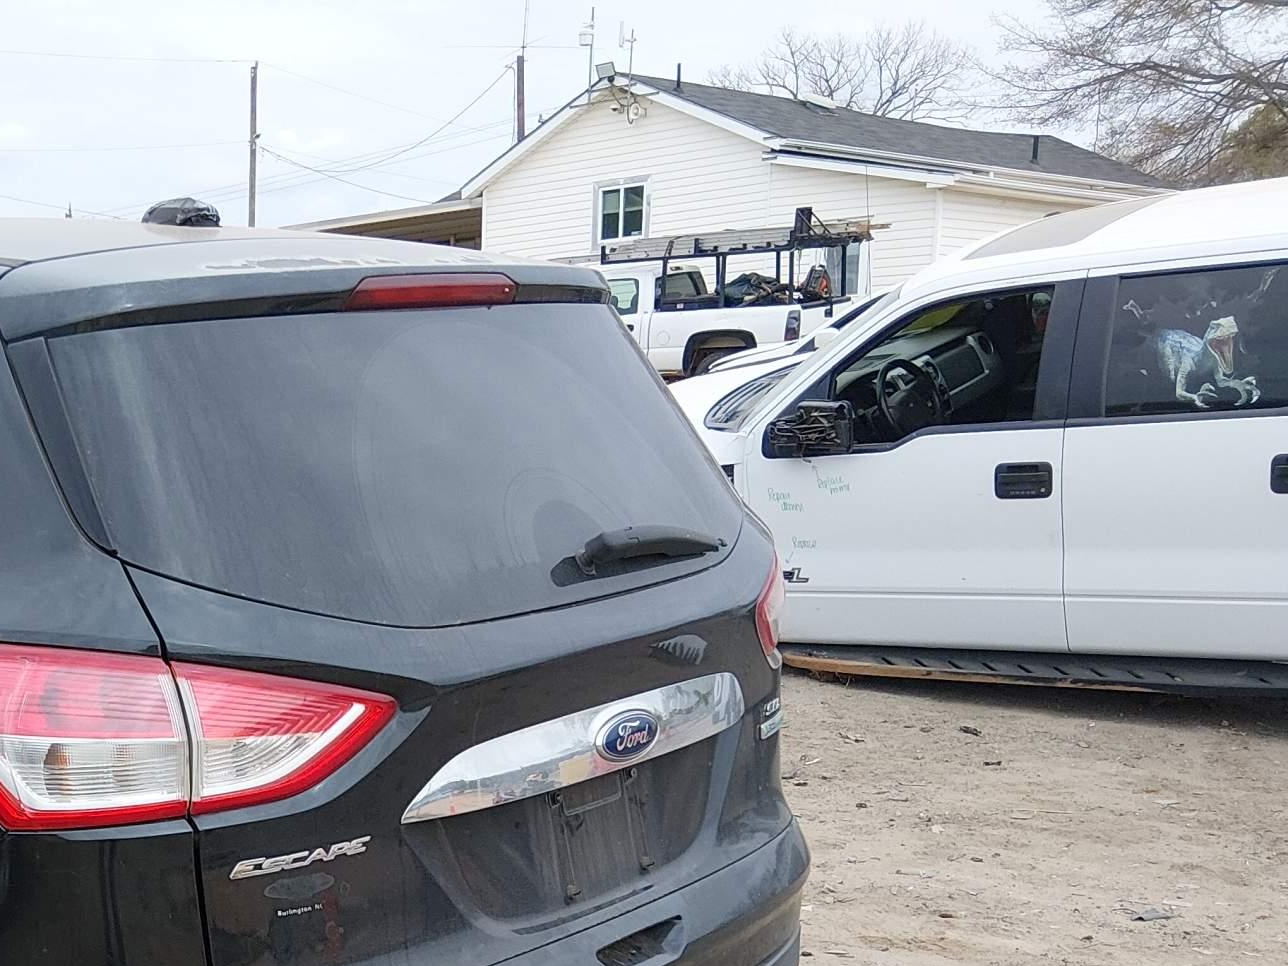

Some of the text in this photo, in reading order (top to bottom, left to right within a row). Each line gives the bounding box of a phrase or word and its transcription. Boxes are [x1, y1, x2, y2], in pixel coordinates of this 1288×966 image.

[616, 720, 649, 751] Ford
[229, 835, 372, 880] ESCAPE
[277, 904, 313, 917] Burlington
